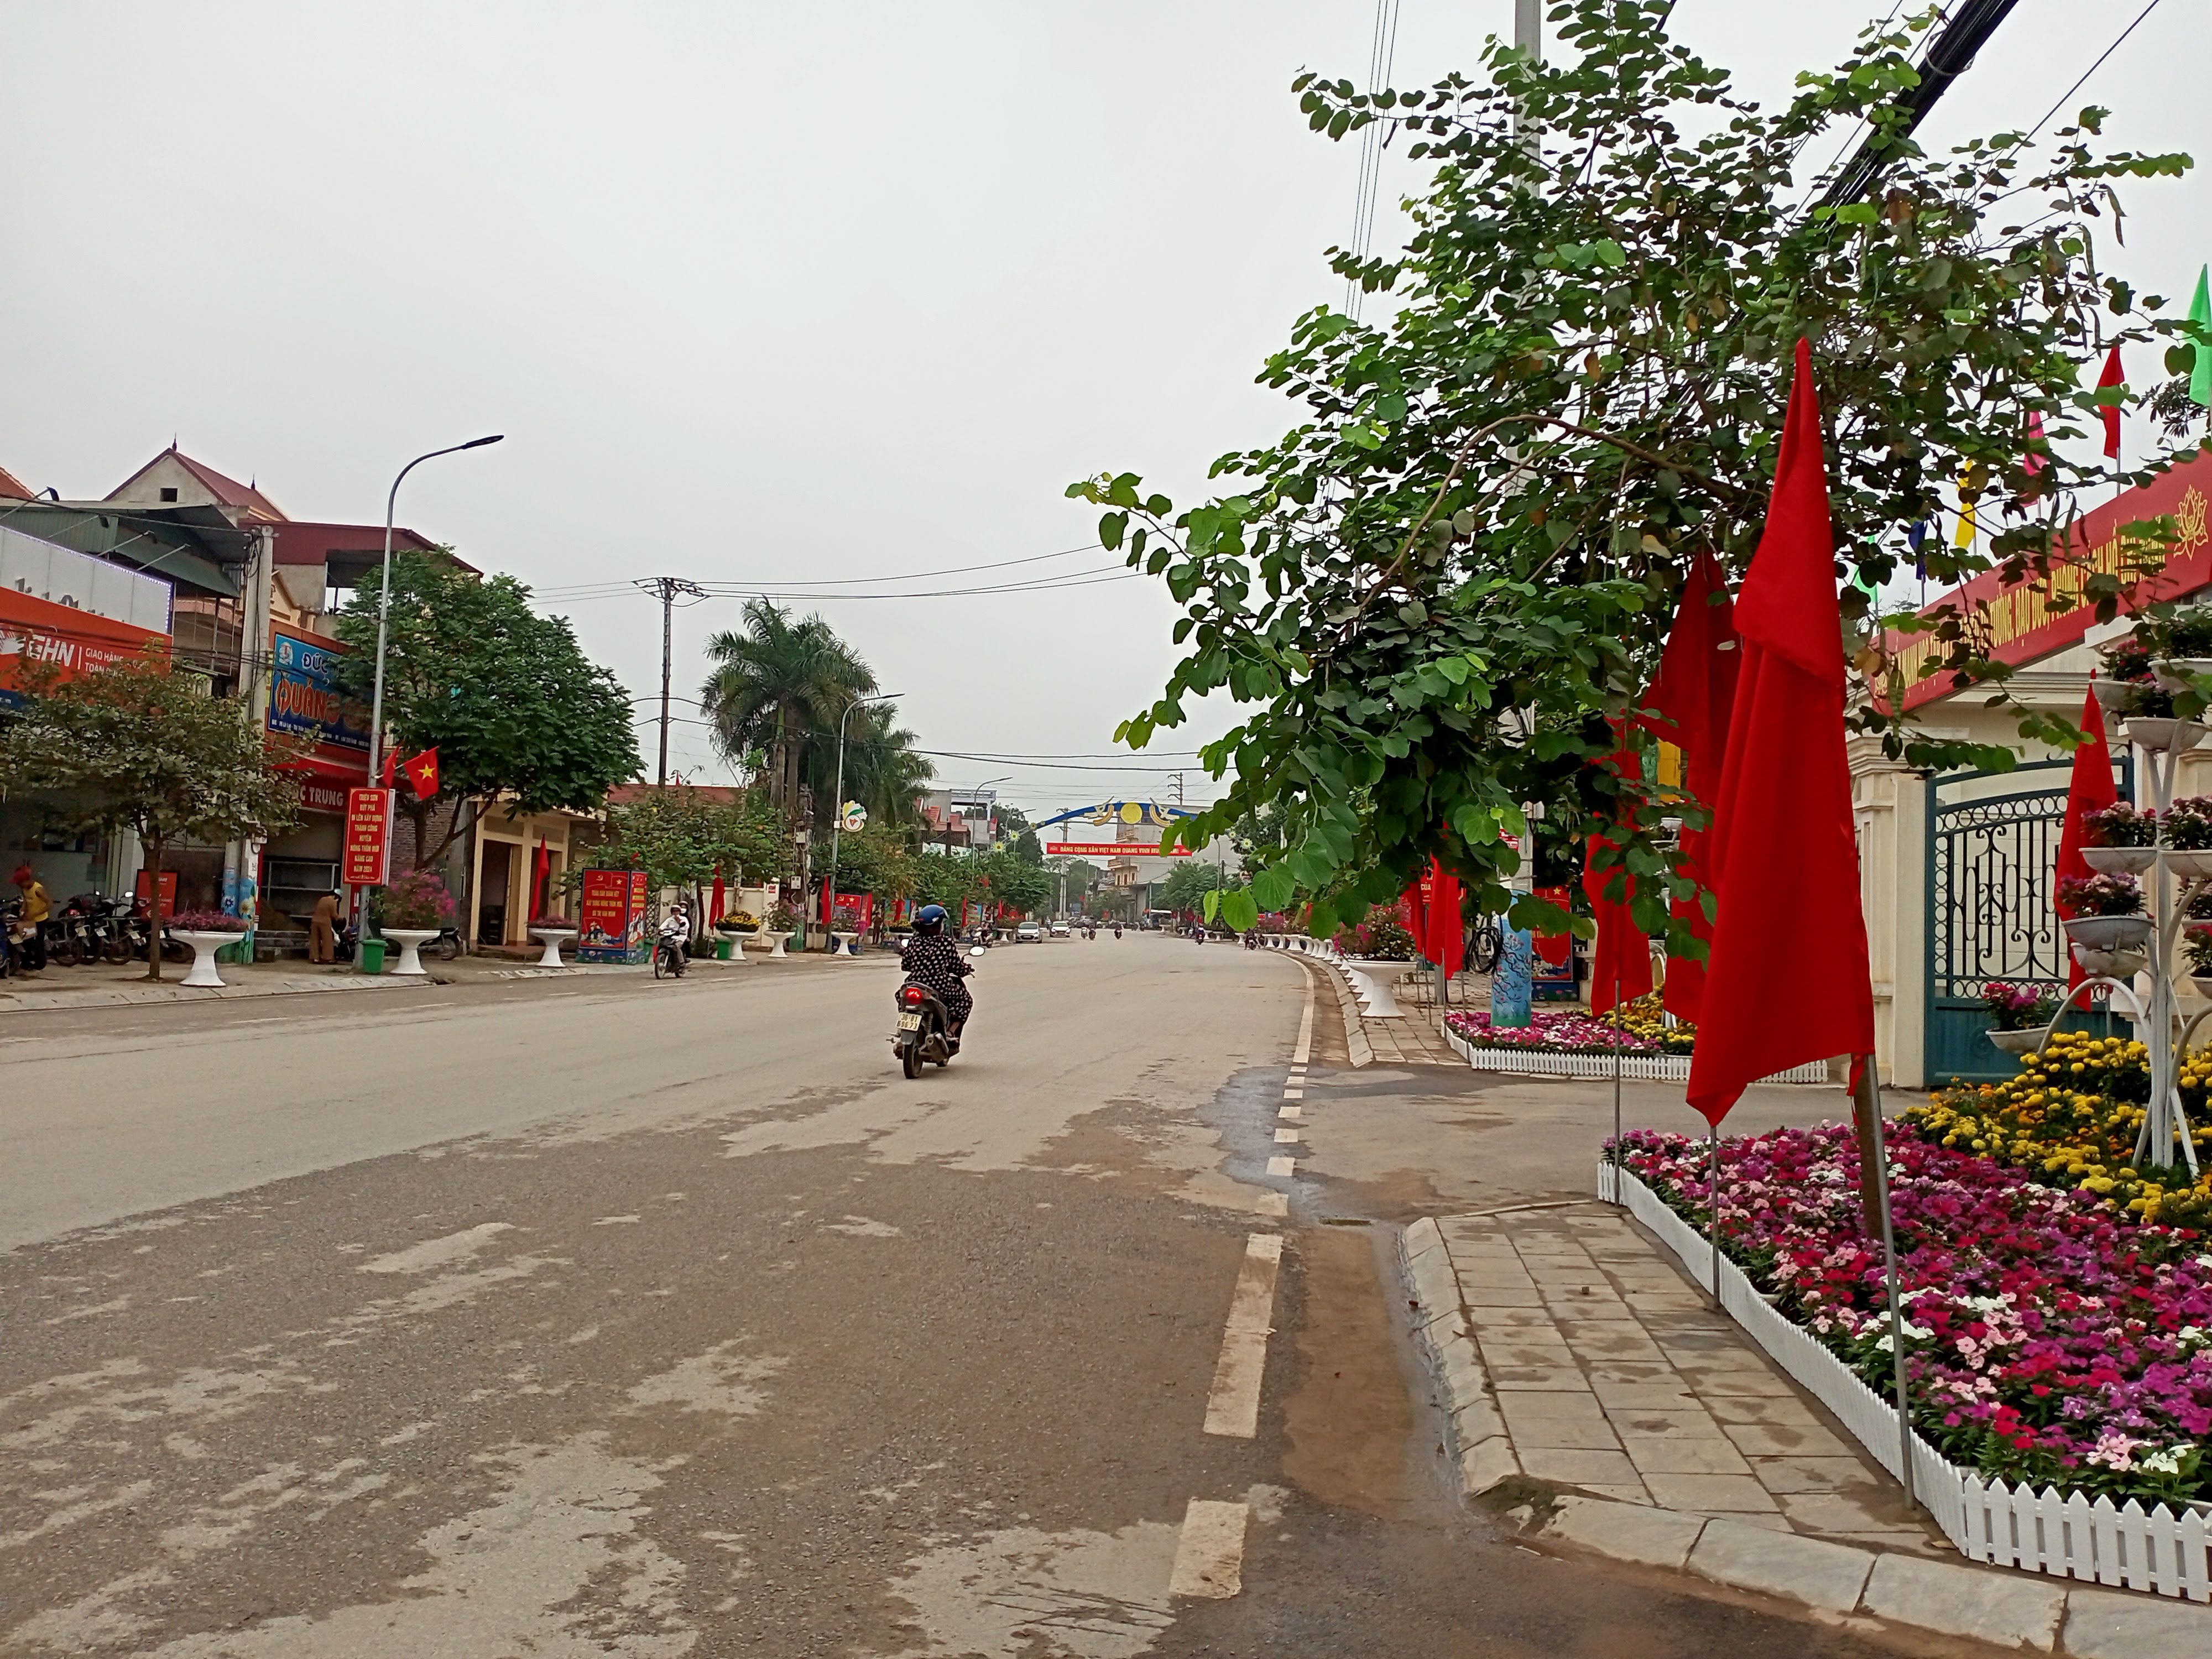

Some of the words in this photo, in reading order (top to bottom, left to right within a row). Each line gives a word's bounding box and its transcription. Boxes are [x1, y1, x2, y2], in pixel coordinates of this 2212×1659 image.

[2015, 583, 2030, 647] ĐẠO
[27, 634, 75, 667] GHN
[85, 648, 103, 660] GIAO
[85, 662, 104, 675] TOÀN
[276, 675, 340, 724] QUẢNG
[309, 786, 343, 806] TRUNG
[1420, 881, 1431, 890] CỦA
